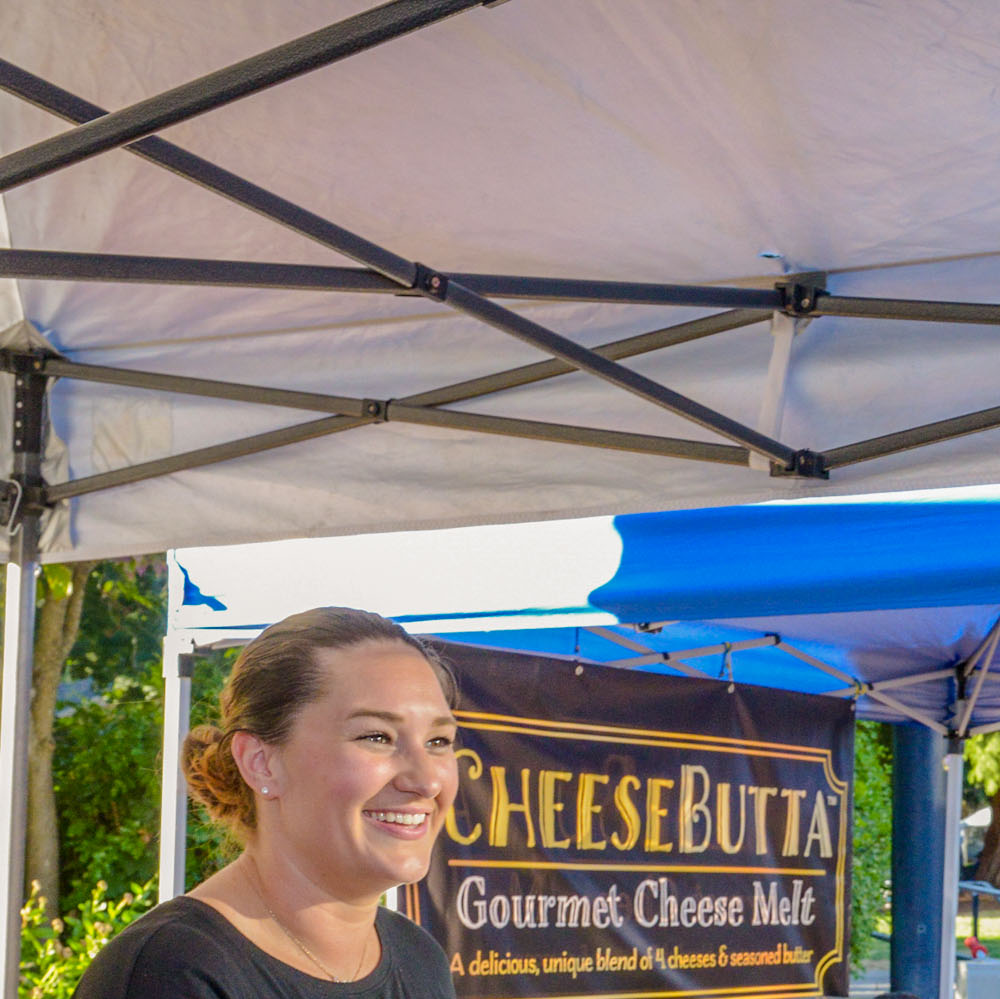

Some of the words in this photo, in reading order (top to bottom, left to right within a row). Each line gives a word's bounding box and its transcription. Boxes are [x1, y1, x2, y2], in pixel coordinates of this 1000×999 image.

[456, 875, 624, 929] Gourmet
[633, 877, 744, 928] Cheese
[752, 879, 816, 926] Melt
[450, 952, 465, 976] A
[468, 950, 540, 976] delicious,
[542, 950, 594, 979] unique
[596, 947, 637, 971] blend
[639, 946, 653, 971] of
[655, 947, 666, 970] 4
[667, 945, 717, 969] cheeses
[718, 944, 729, 967] &
[730, 942, 782, 967] seasoned
[783, 943, 814, 965] butter
